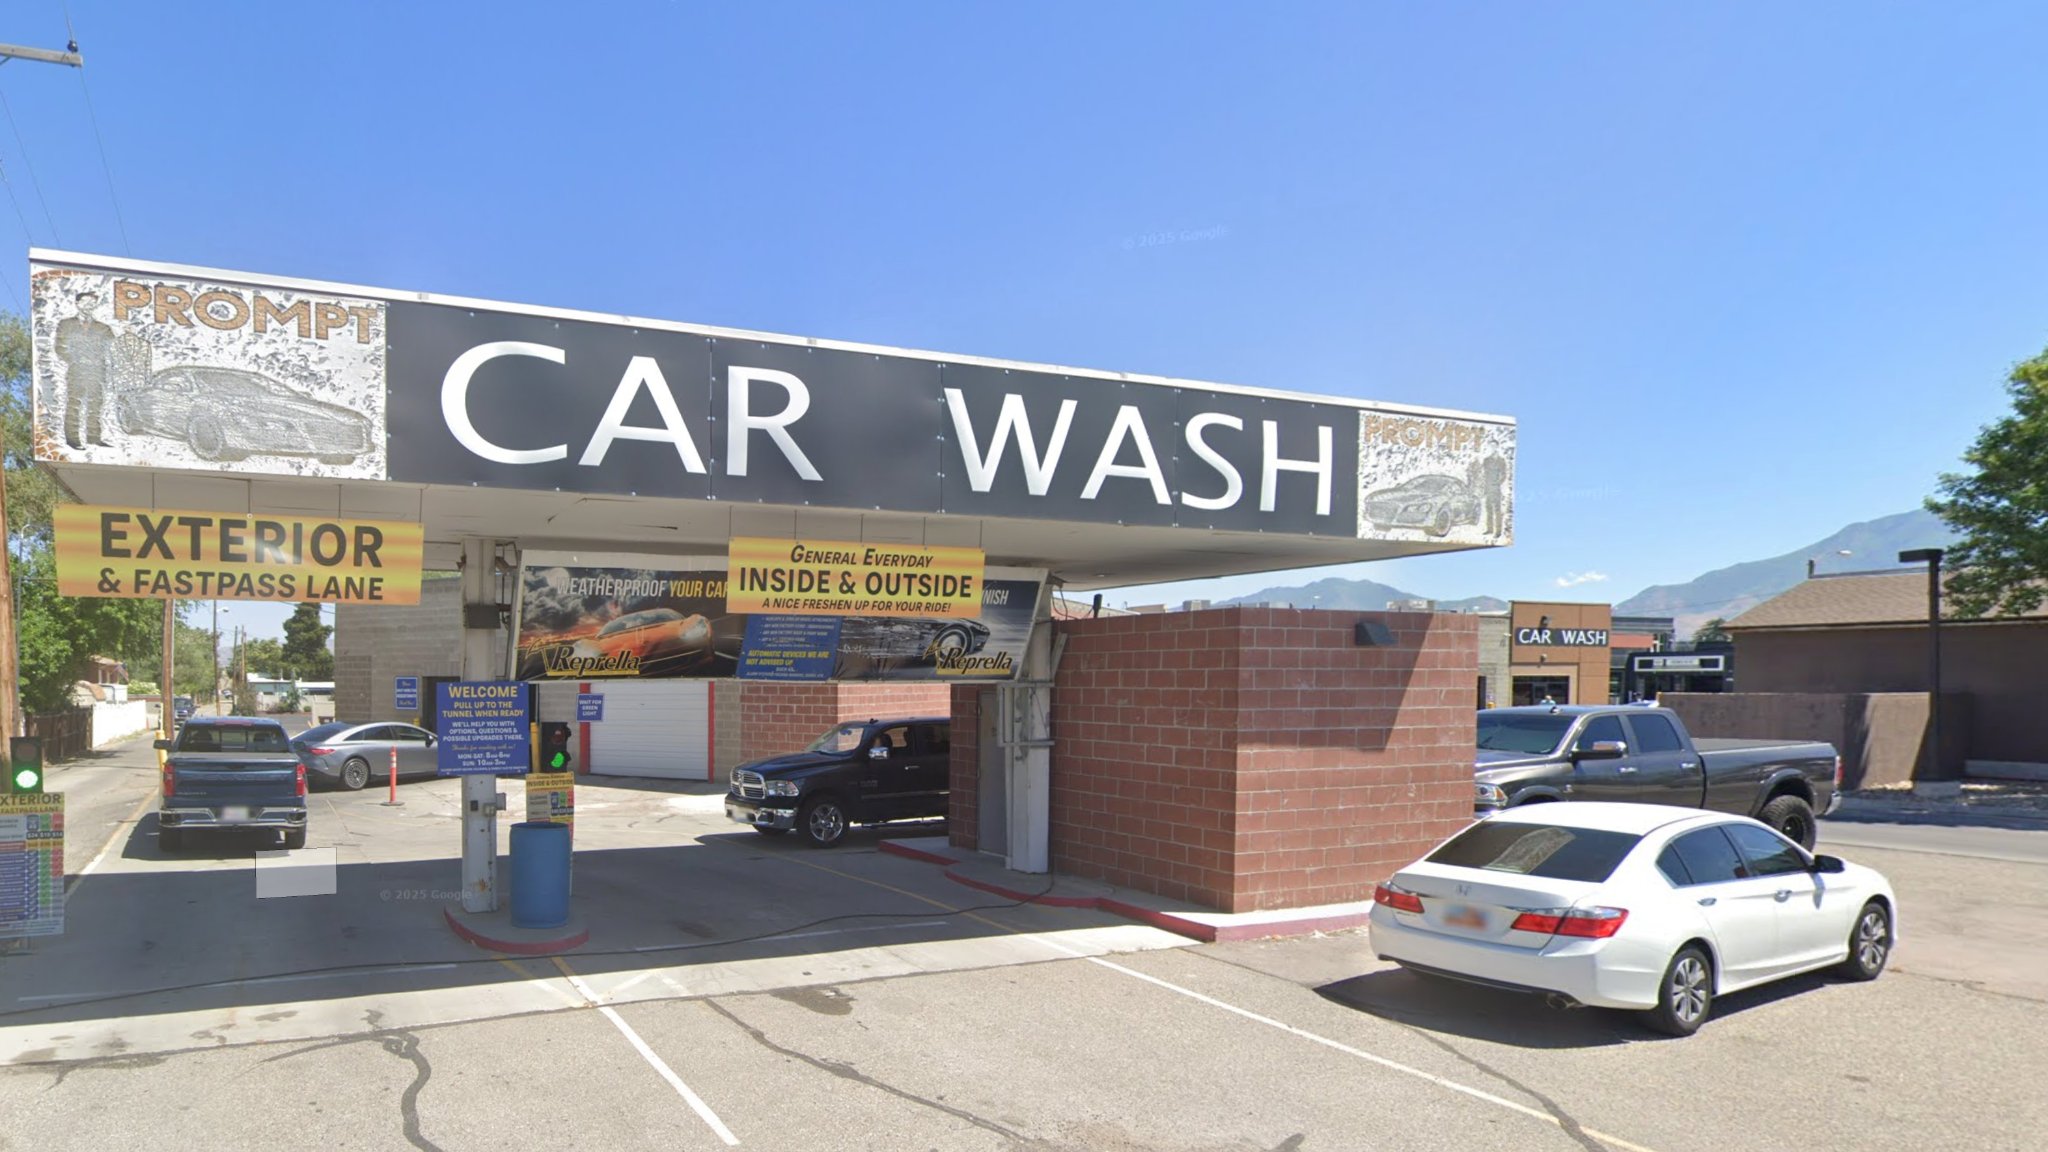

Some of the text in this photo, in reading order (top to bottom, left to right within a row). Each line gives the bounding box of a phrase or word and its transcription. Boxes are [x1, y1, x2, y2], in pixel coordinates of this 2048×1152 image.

[113, 280, 377, 344] PROMPT
[441, 340, 1333, 516] CAR WASH
[1364, 415, 1484, 453] PROMPT
[101, 512, 383, 568] EXTERIOR
[97, 567, 384, 600] & FASTPASS LANE
[556, 577, 668, 598] WEATHERPROOF
[669, 580, 703, 598] YOUR
[740, 567, 972, 597] INSIDE & OUTSIDE
[762, 598, 951, 613] A NICE FRESHEN UP FOR YOUR RIDE!
[982, 589, 1010, 605] NISH
[1519, 628, 1607, 646] CAR WASH
[553, 645, 641, 677] Reprella
[939, 648, 1013, 675] Reprella
[448, 686, 518, 698] WELCOME
[442, 710, 474, 718] TUNNEL
[500, 709, 524, 717] READY
[454, 701, 472, 709] PULL
[0, 794, 61, 806] XTERIOR
